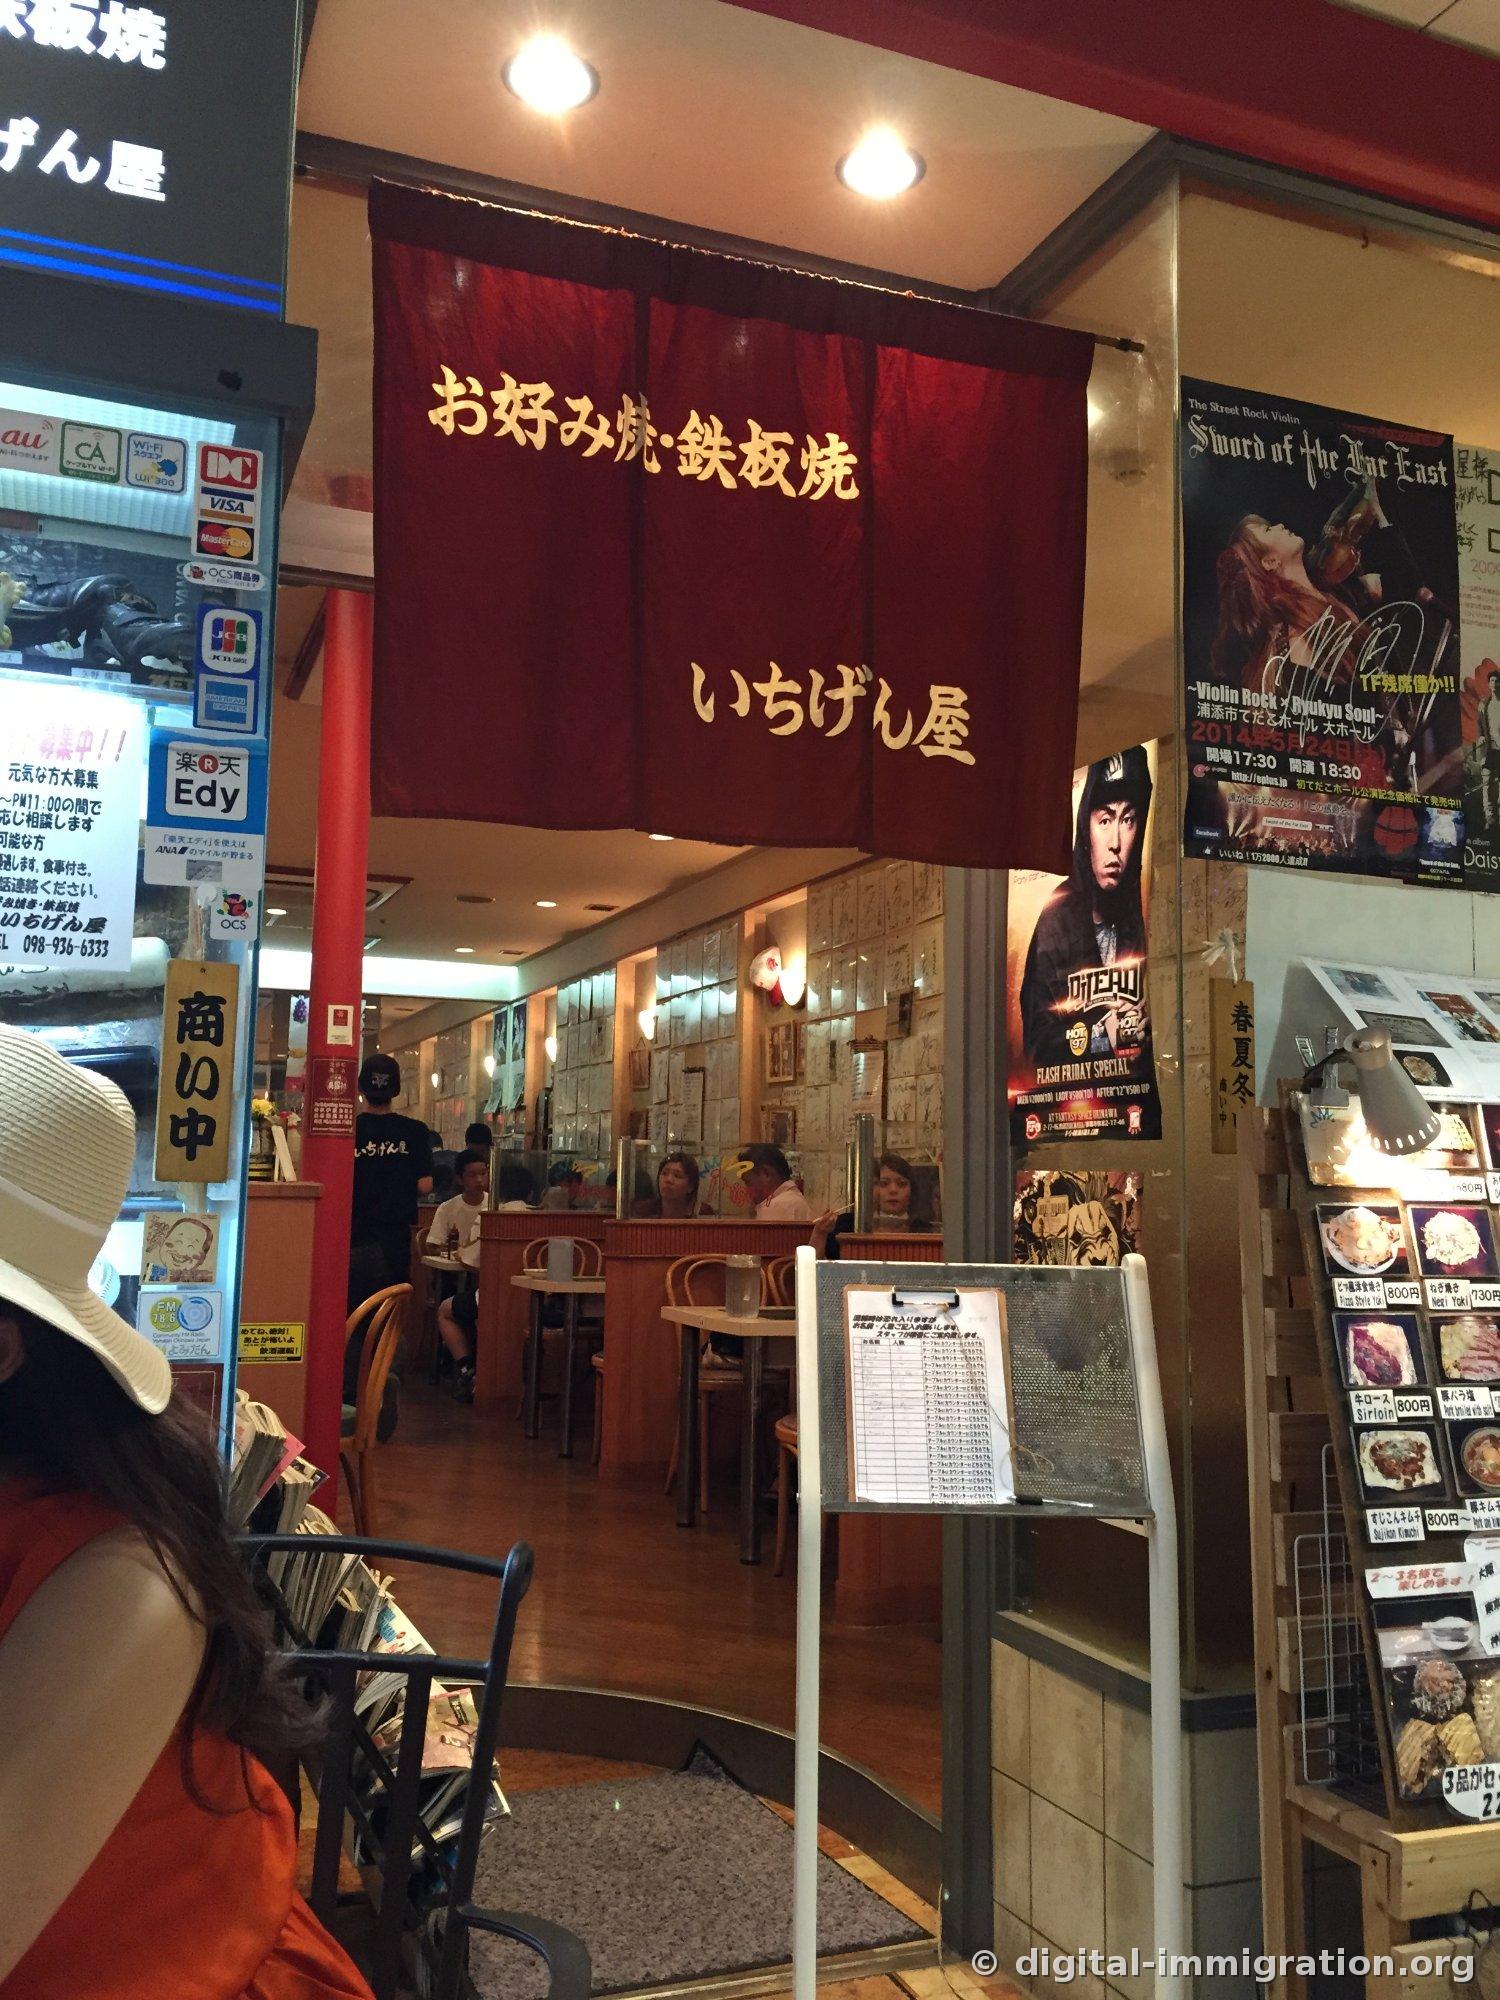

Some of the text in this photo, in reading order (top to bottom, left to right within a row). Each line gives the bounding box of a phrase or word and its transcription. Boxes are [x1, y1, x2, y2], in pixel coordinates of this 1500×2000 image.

[1188, 398, 1301, 425] The Street Rock Violin
[1, 430, 48, 449] au
[428, 364, 859, 500] お好み焼・鉄板焼
[133, 440, 163, 453] Wi-Fi
[1187, 414, 1266, 461] Sword
[1271, 434, 1295, 465] of
[1300, 429, 1340, 491] the
[207, 452, 252, 483] DC
[210, 497, 244, 514] VISA
[200, 533, 249, 547] MasterCard
[212, 630, 247, 642] JCB
[1241, 688, 1277, 710] Rock
[1292, 696, 1343, 720] Ryukyu
[691, 661, 976, 766] いちげん屋
[1206, 747, 1277, 770] 開場17:30
[1289, 757, 1315, 775] 開演
[1320, 762, 1362, 780] 18:30
[8, 763, 99, 789] 元気な方大募集
[1231, 771, 1288, 788] http://eplus.jp
[174, 778, 240, 814] Edy
[155, 845, 178, 855] ANA
[0, 896, 80, 913] み焼き・鉄板焼
[0, 912, 108, 934] いちげん屋
[221, 919, 247, 930] OCS
[23, 934, 109, 958] 098-936-6333
[1066, 1027, 1087, 1040] HOT
[1072, 1038, 1085, 1049] 97
[170, 991, 226, 1161] 商い中
[1036, 1058, 1130, 1084] FLASH FRIDAY SPECIAL
[1387, 1287, 1420, 1299] 800円
[1471, 1289, 1500, 1301] 730円
[157, 1302, 176, 1312] FM
[1355, 1392, 1391, 1405] 牛ロース
[1397, 1400, 1430, 1412] 800円
[1357, 1409, 1395, 1421] Sirloin
[1371, 1511, 1421, 1525] すじこんキムチ
[1444, 1767, 1500, 1794] 3品がセ
